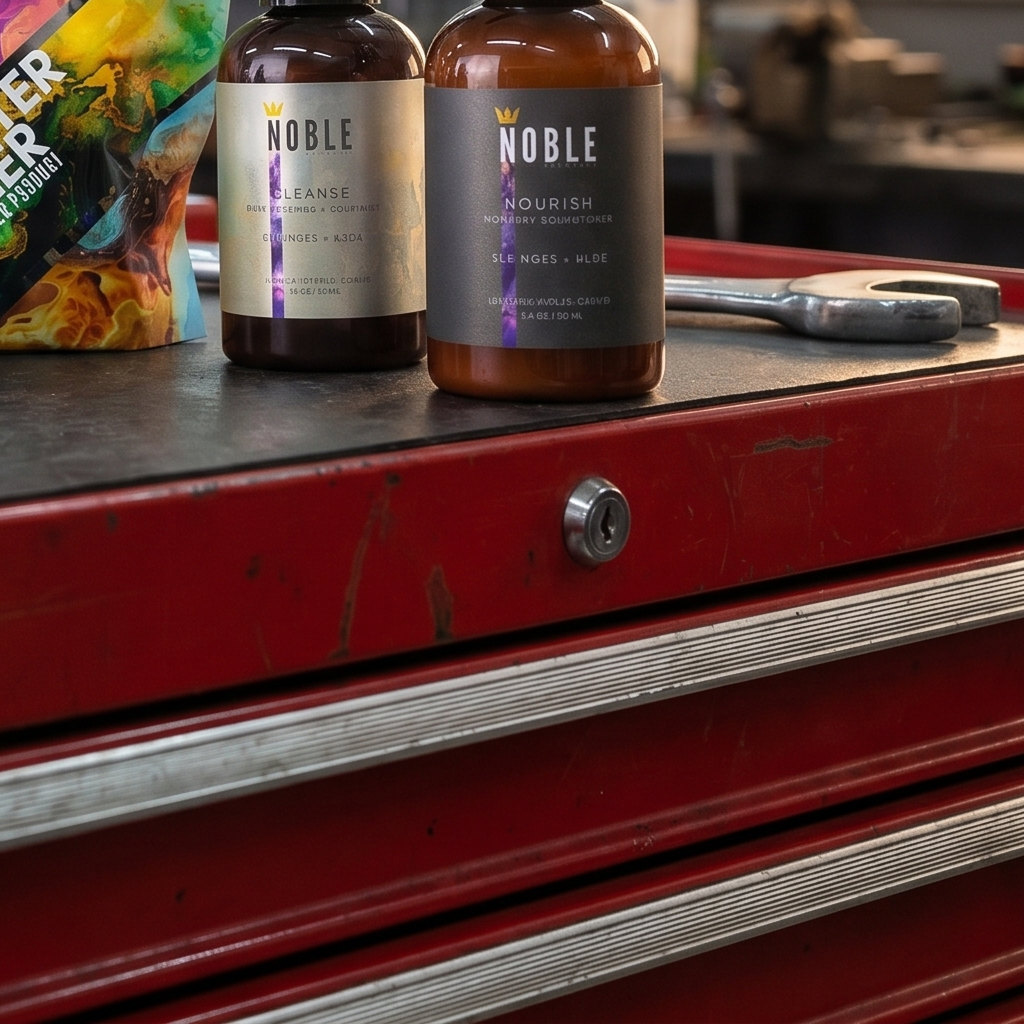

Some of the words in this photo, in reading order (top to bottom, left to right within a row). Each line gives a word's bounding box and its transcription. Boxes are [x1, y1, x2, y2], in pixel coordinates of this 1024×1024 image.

[268, 119, 352, 151] NOBLE
[499, 126, 597, 163] NOBLE
[505, 197, 592, 211] NOURISH
